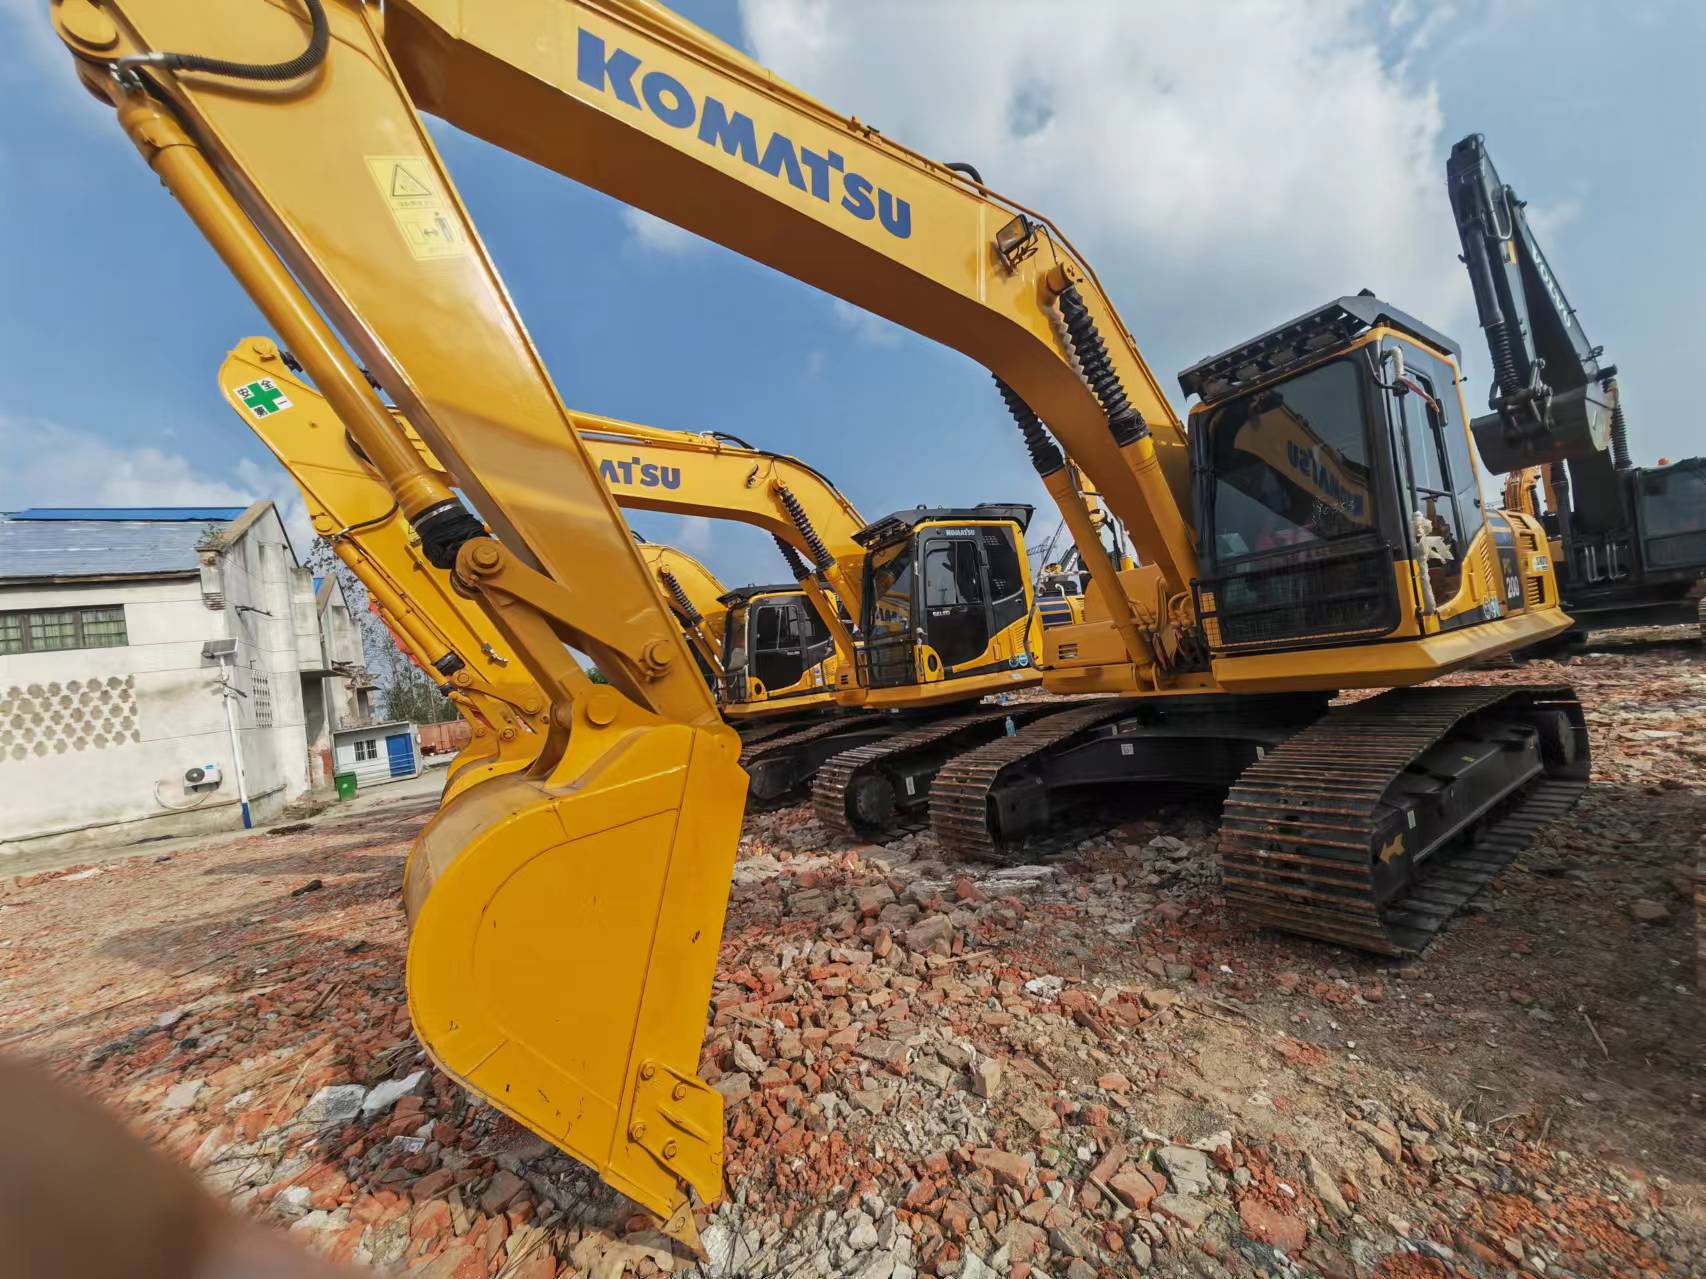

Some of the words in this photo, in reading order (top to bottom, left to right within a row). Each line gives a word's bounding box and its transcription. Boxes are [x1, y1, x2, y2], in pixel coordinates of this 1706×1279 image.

[578, 26, 912, 239] KOMATSU
[1530, 239, 1571, 328] VOLVO
[600, 456, 681, 490] ATSU
[1506, 575, 1520, 599] 200
